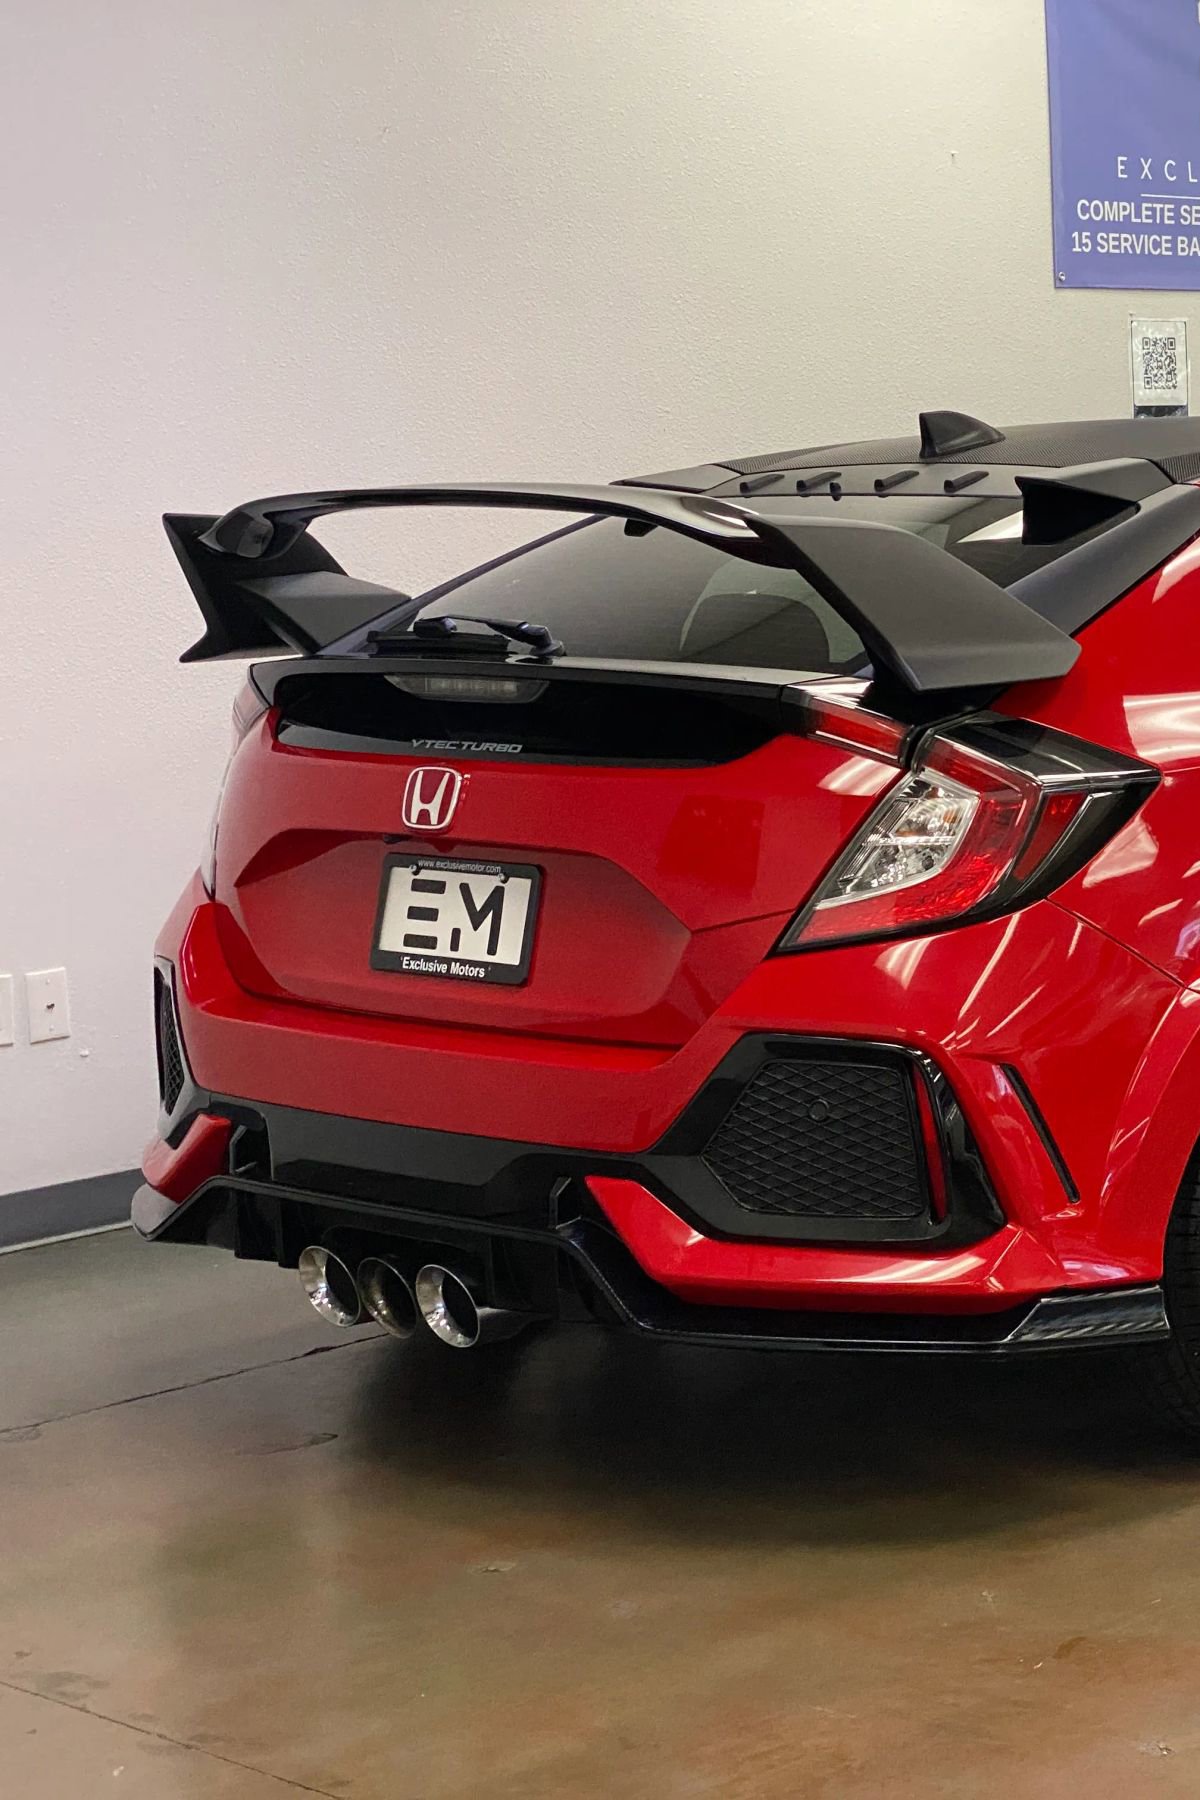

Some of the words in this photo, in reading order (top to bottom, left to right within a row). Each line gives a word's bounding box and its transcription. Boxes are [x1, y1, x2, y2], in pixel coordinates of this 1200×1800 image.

[1076, 199, 1175, 225] COMPLETE
[1072, 231, 1092, 253] 15
[1096, 233, 1172, 256] SERVICE
[418, 859, 502, 873] www.exclusivemotor.com
[403, 878, 505, 956] EM
[402, 956, 448, 974] Exclusive
[450, 961, 486, 978] Motors
